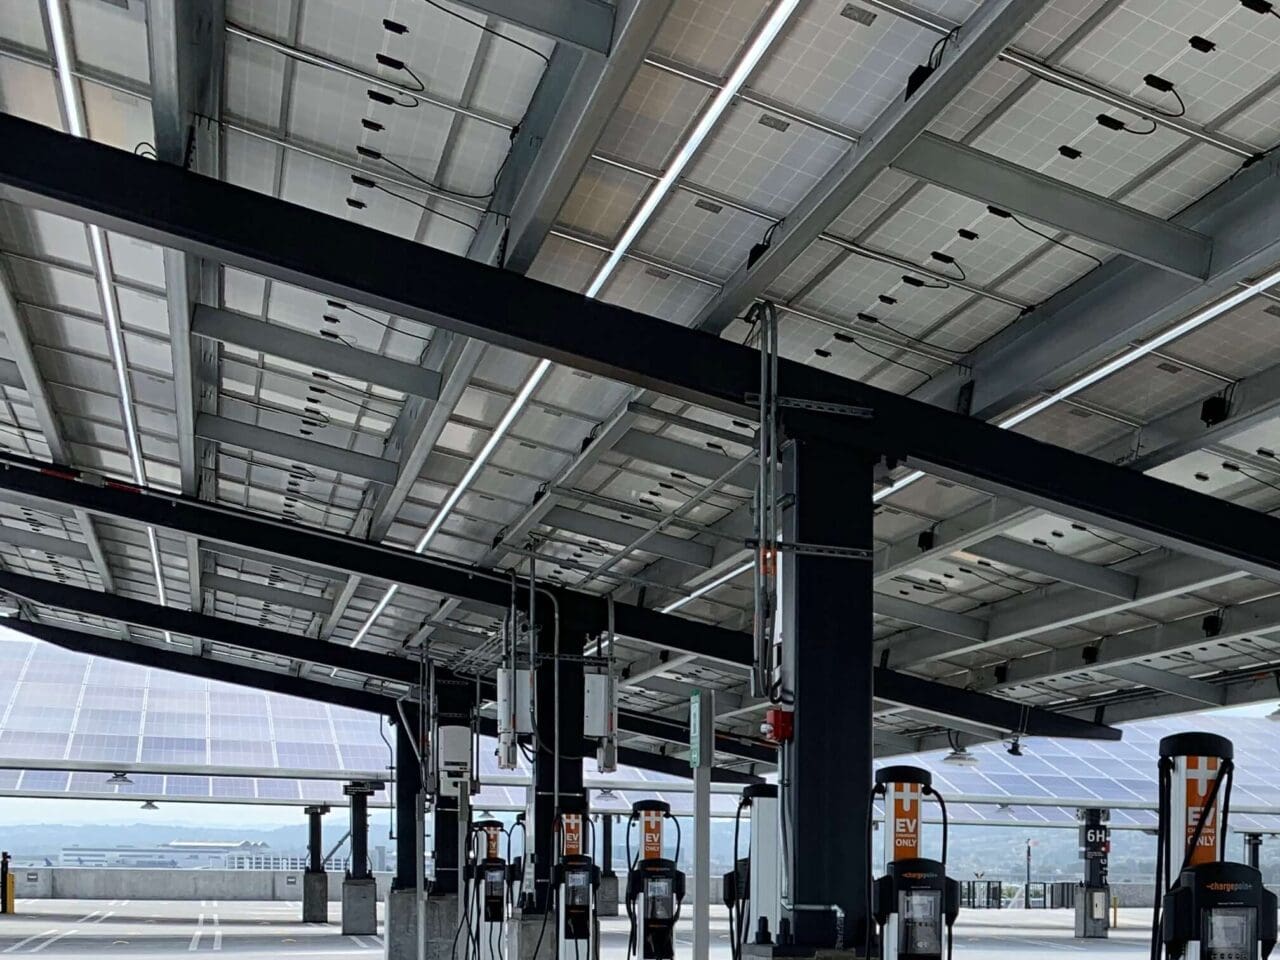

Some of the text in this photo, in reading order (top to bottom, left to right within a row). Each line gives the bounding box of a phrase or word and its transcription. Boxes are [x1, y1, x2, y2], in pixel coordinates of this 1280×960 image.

[896, 819, 917, 832] EV
[567, 833, 579, 841] EV
[646, 833, 660, 842] EV
[1087, 829, 1105, 842] 6H
[896, 838, 917, 848] ONLY
